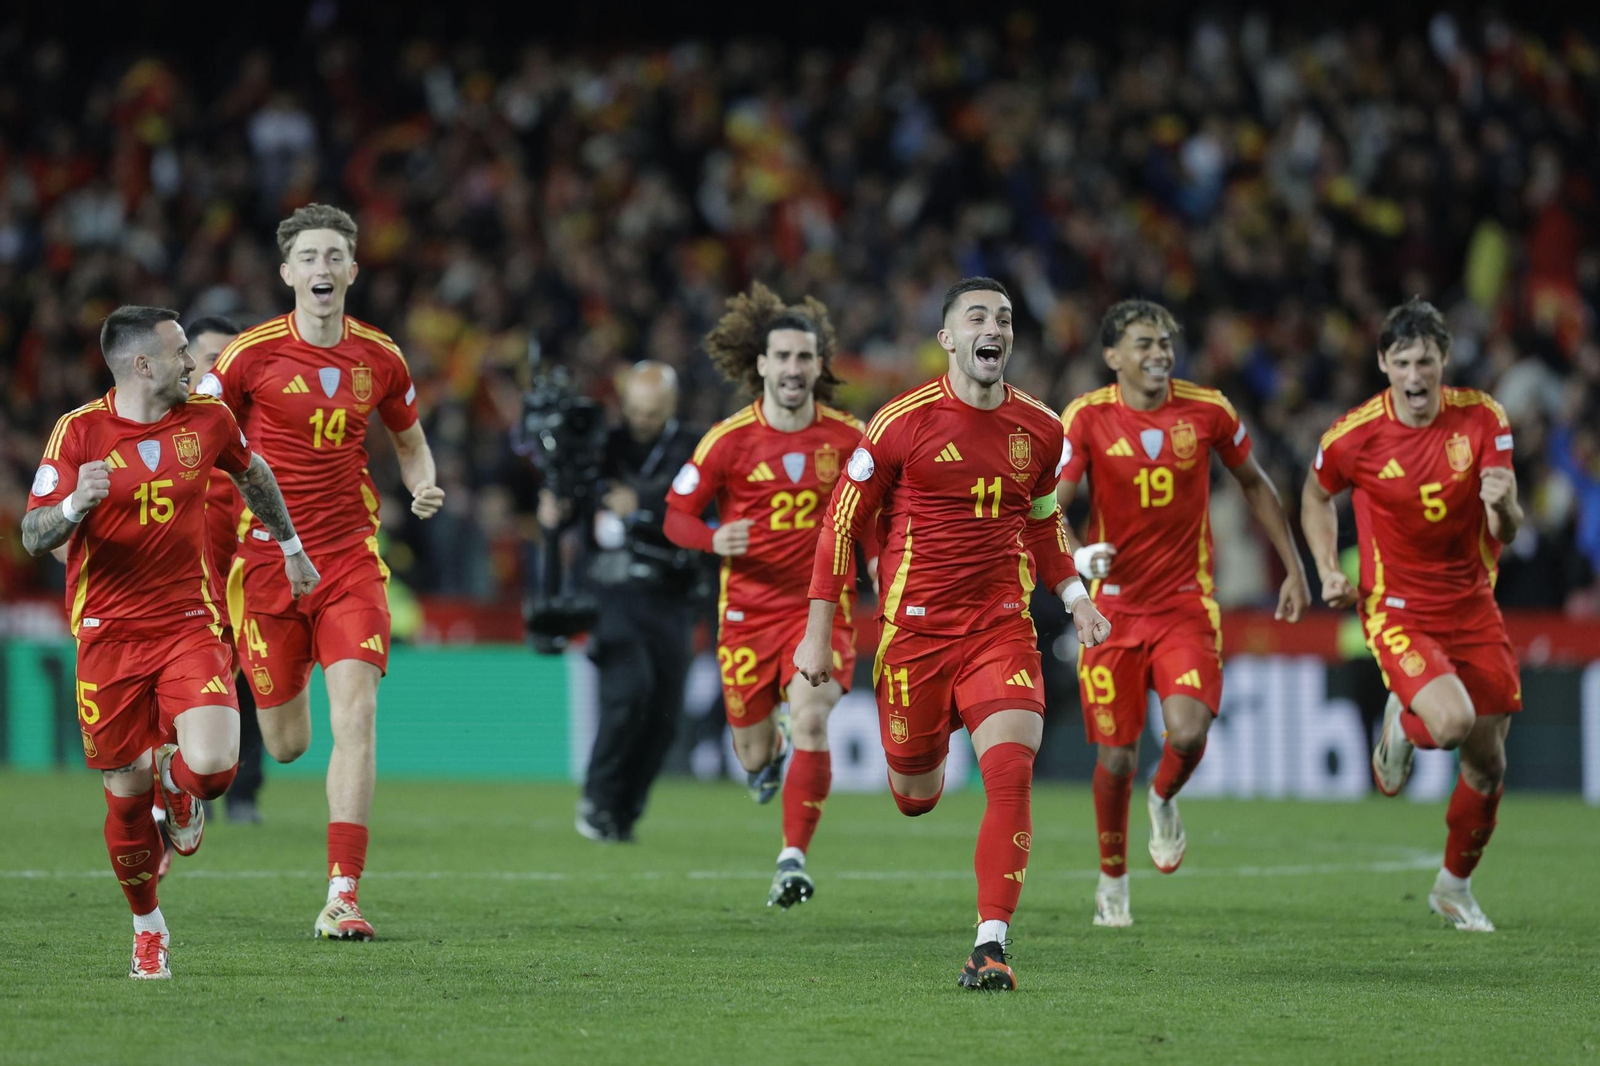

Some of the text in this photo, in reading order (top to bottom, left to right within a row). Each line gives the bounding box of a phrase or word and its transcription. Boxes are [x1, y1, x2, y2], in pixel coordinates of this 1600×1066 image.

[309, 408, 347, 448] 14
[134, 479, 175, 525] 15
[971, 477, 1002, 518] 11
[1133, 466, 1174, 509] 19
[1420, 482, 1447, 523] 5
[770, 490, 818, 530] 22
[243, 618, 269, 662] 14
[1382, 625, 1411, 655] 5
[718, 646, 757, 685] 22
[883, 663, 910, 707] 11
[1079, 665, 1116, 704] 19
